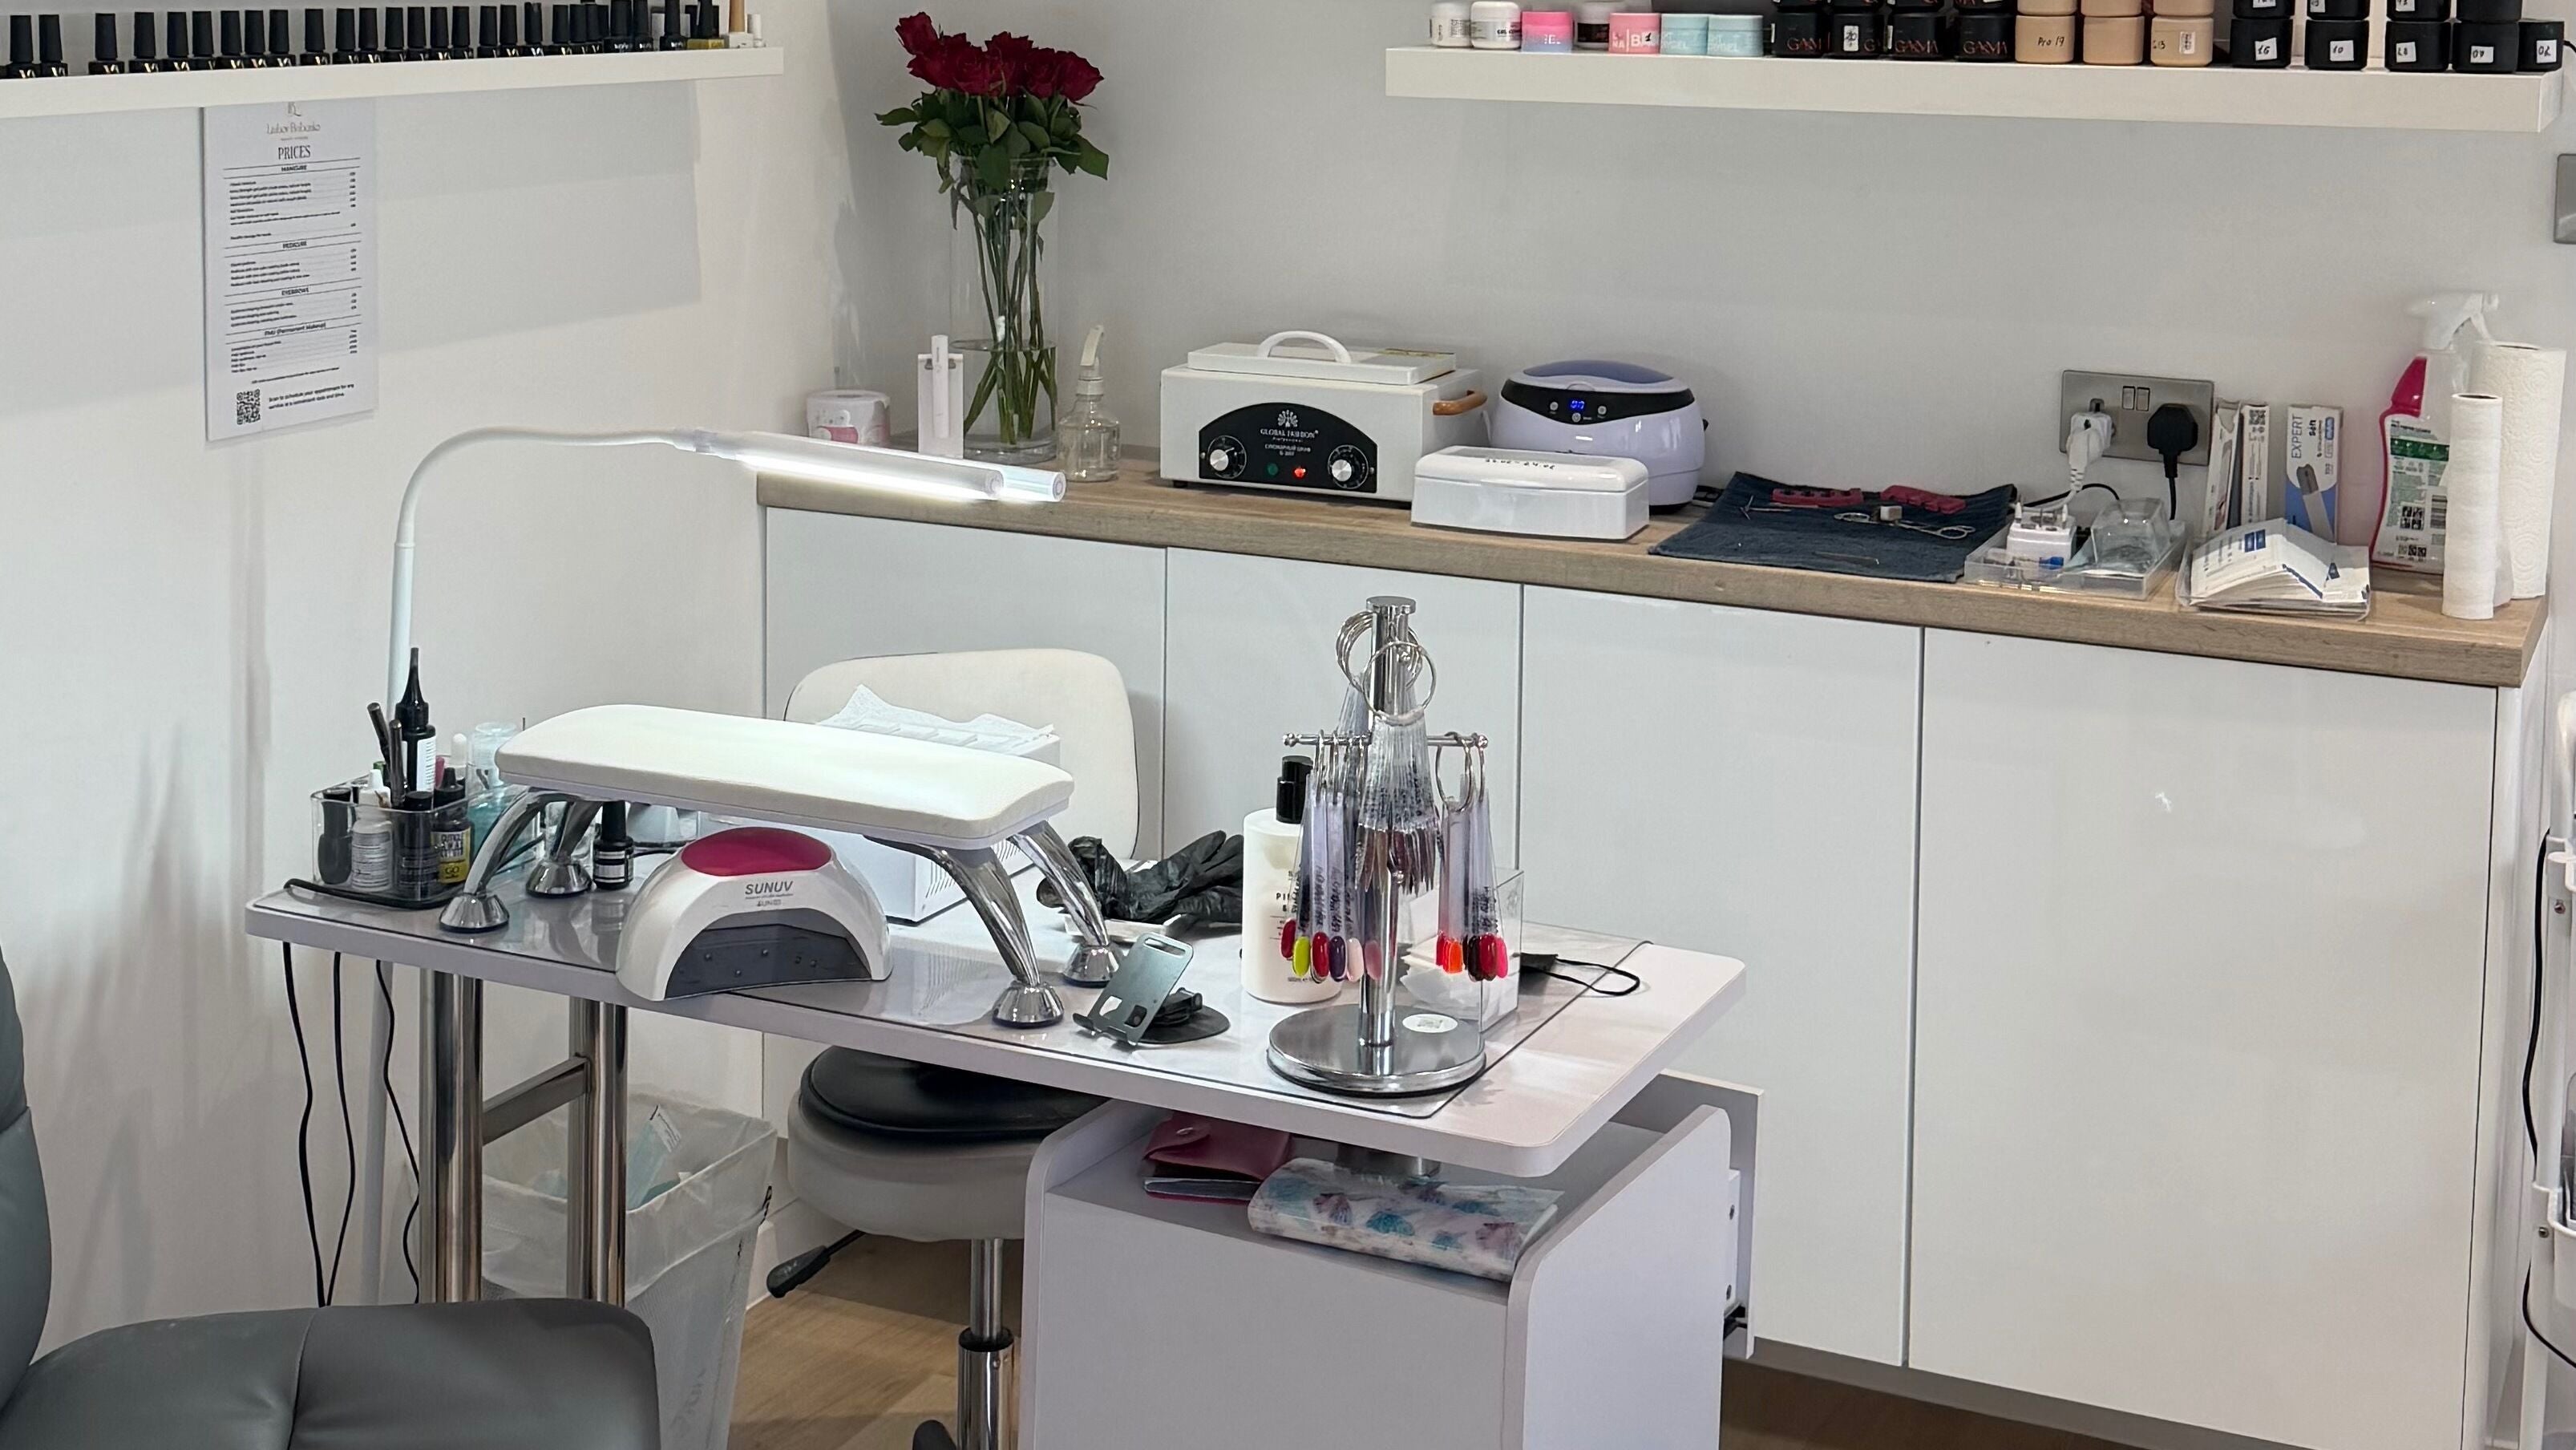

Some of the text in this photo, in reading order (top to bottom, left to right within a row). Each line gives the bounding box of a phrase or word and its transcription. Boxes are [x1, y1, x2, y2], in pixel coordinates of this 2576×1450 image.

[277, 144, 311, 160] PRICES
[2291, 413, 2303, 459] EXPERT
[745, 881, 794, 895] SUNUV
